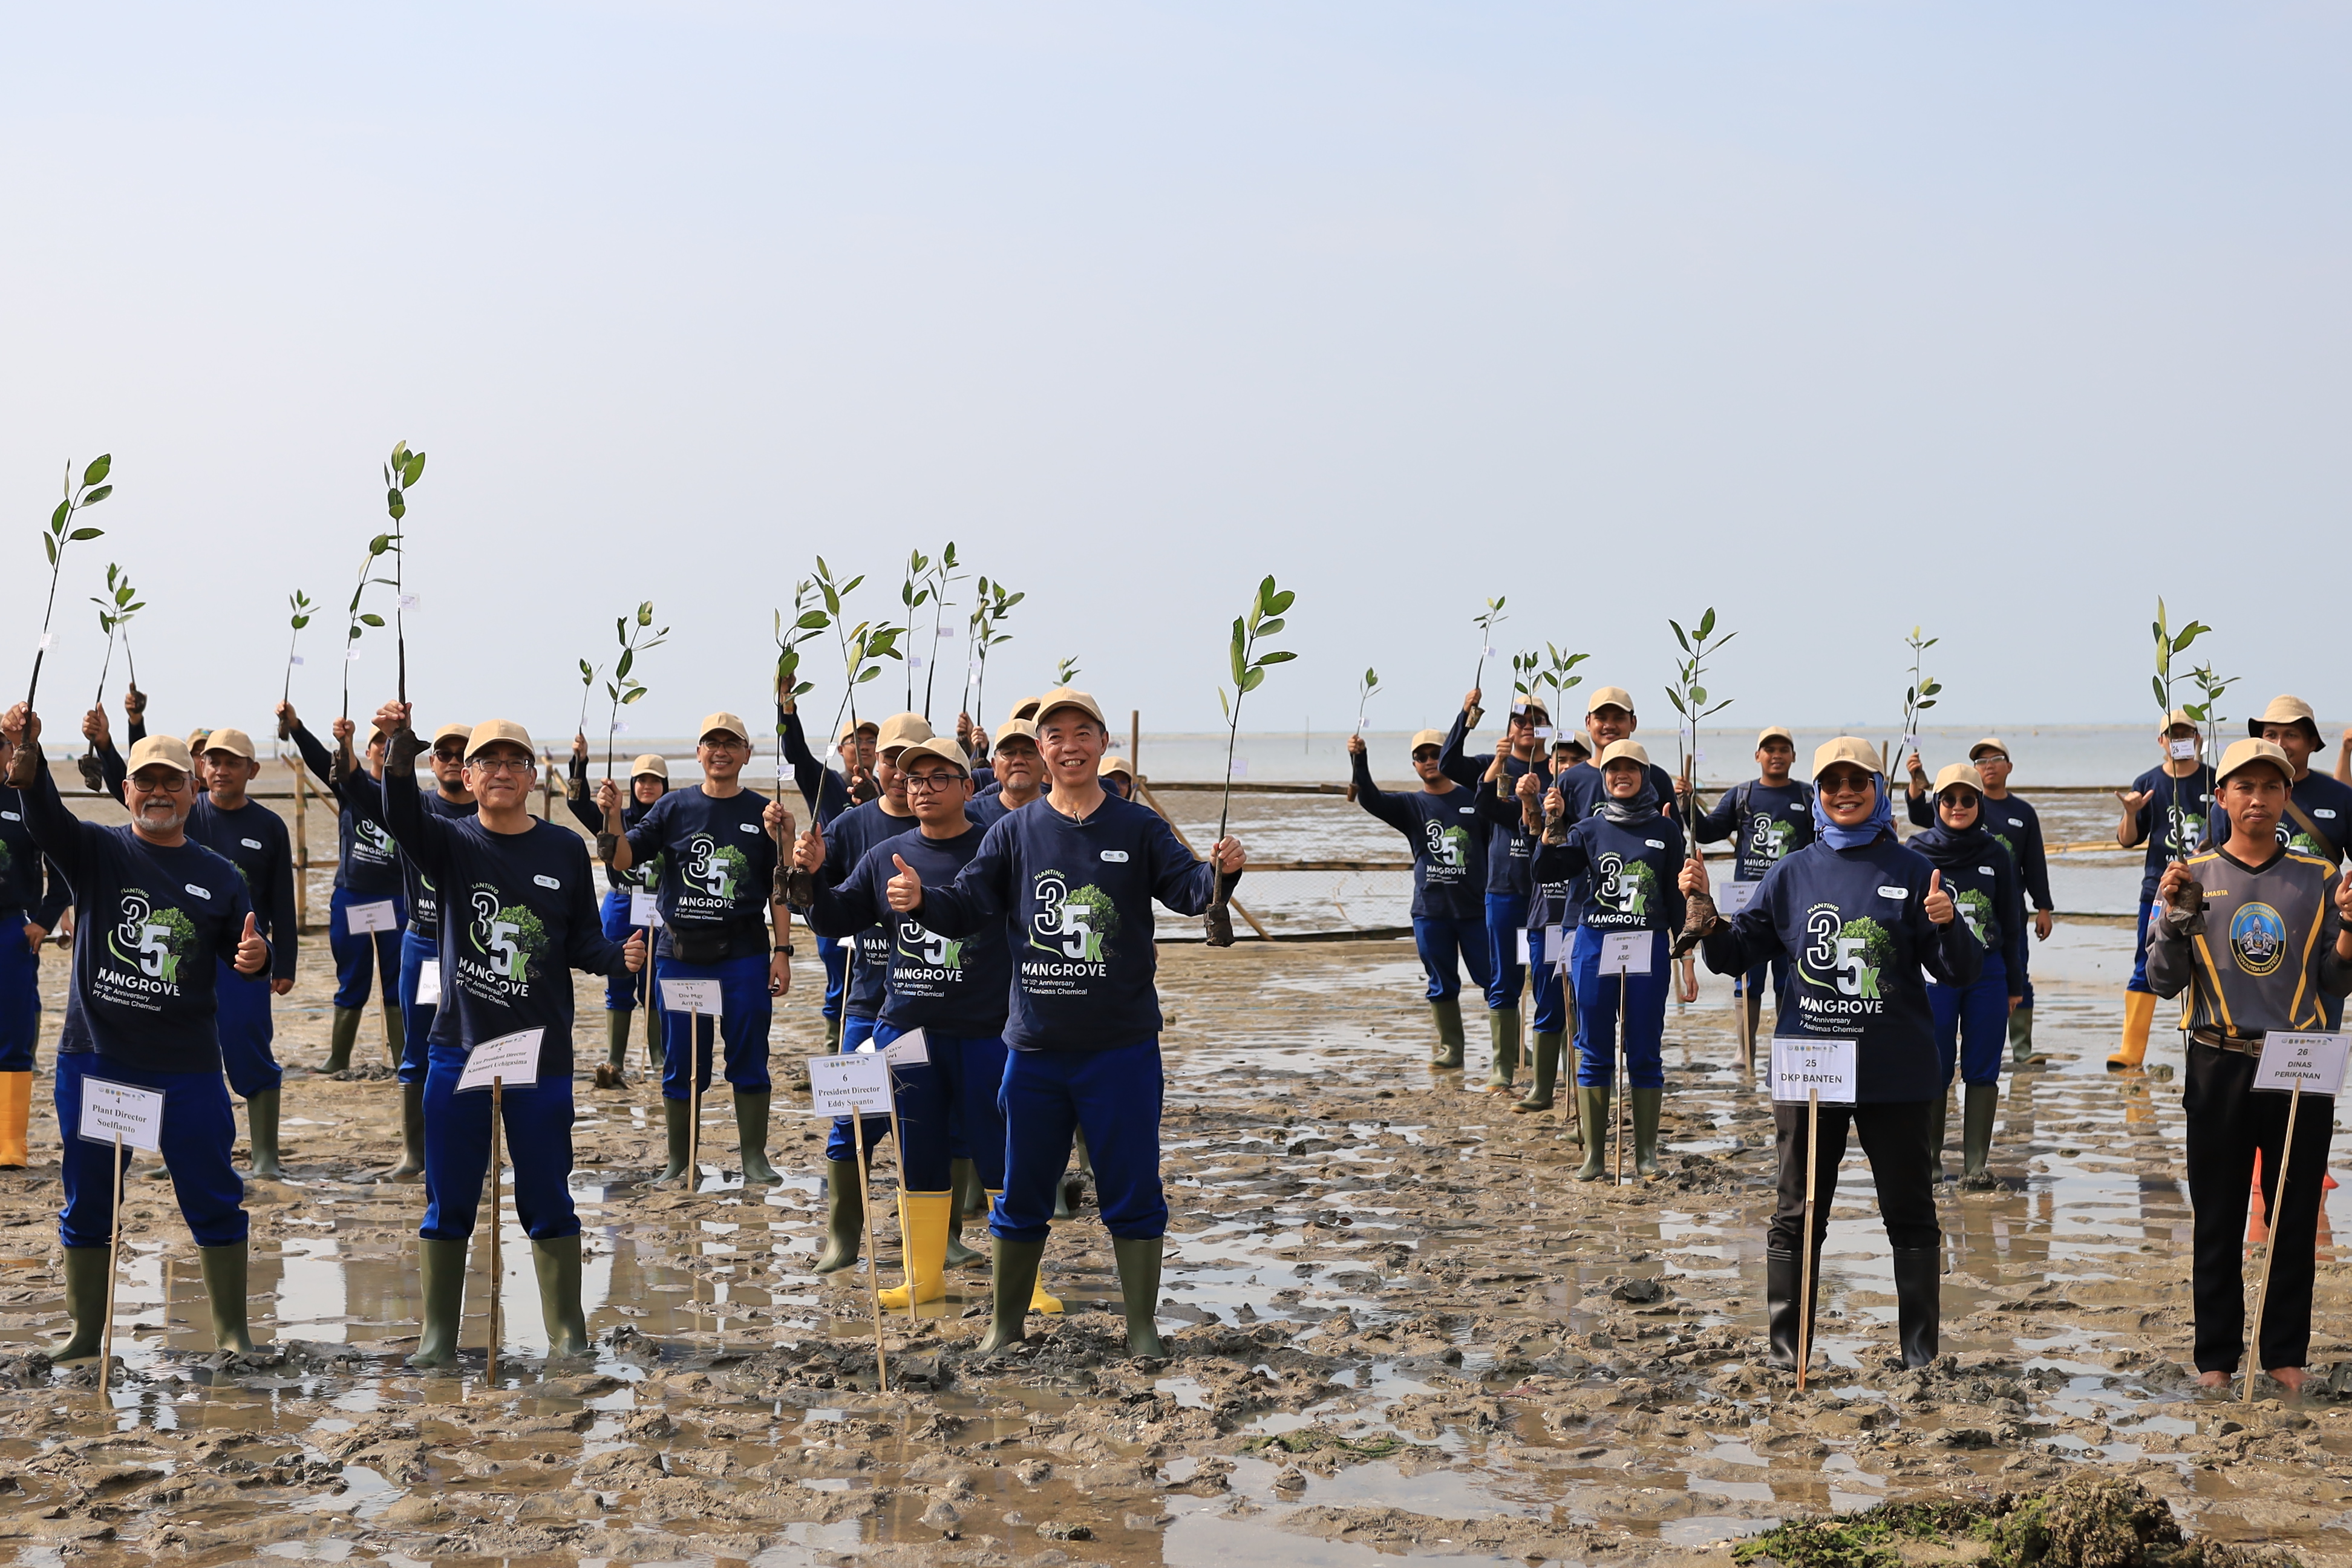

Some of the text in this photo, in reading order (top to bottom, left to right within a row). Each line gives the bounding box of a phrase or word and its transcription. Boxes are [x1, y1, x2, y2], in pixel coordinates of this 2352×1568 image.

[1426, 823, 1465, 867] 35K
[688, 838, 738, 900] 35K
[1600, 857, 1647, 916] 35K
[678, 897, 735, 909] MANGROVE
[1807, 902, 1840, 915] PLANTING
[1034, 878, 1105, 962] 35K
[1587, 913, 1647, 927] MANGROVE
[118, 895, 181, 984] 35K
[1806, 910, 1881, 999] 35K
[2237, 953, 2261, 972] KWARDA
[458, 956, 529, 997] MANGOVE
[893, 967, 964, 982] MANGROVE
[1022, 962, 1106, 977] MANGROVE
[97, 967, 180, 996] MANGROVE
[113, 988, 150, 1002] Anniversary
[131, 1001, 162, 1012] Chemical
[1799, 996, 1884, 1014] MANGROVE
[1813, 1016, 1851, 1025] Anniversary
[1781, 1073, 1843, 1083] DKP BANTEN
[2275, 1071, 2321, 1080] PERIKANAN
[818, 1088, 850, 1097] President
[93, 1104, 147, 1123] Plant Director
[97, 1118, 136, 1134] Soelfianto
